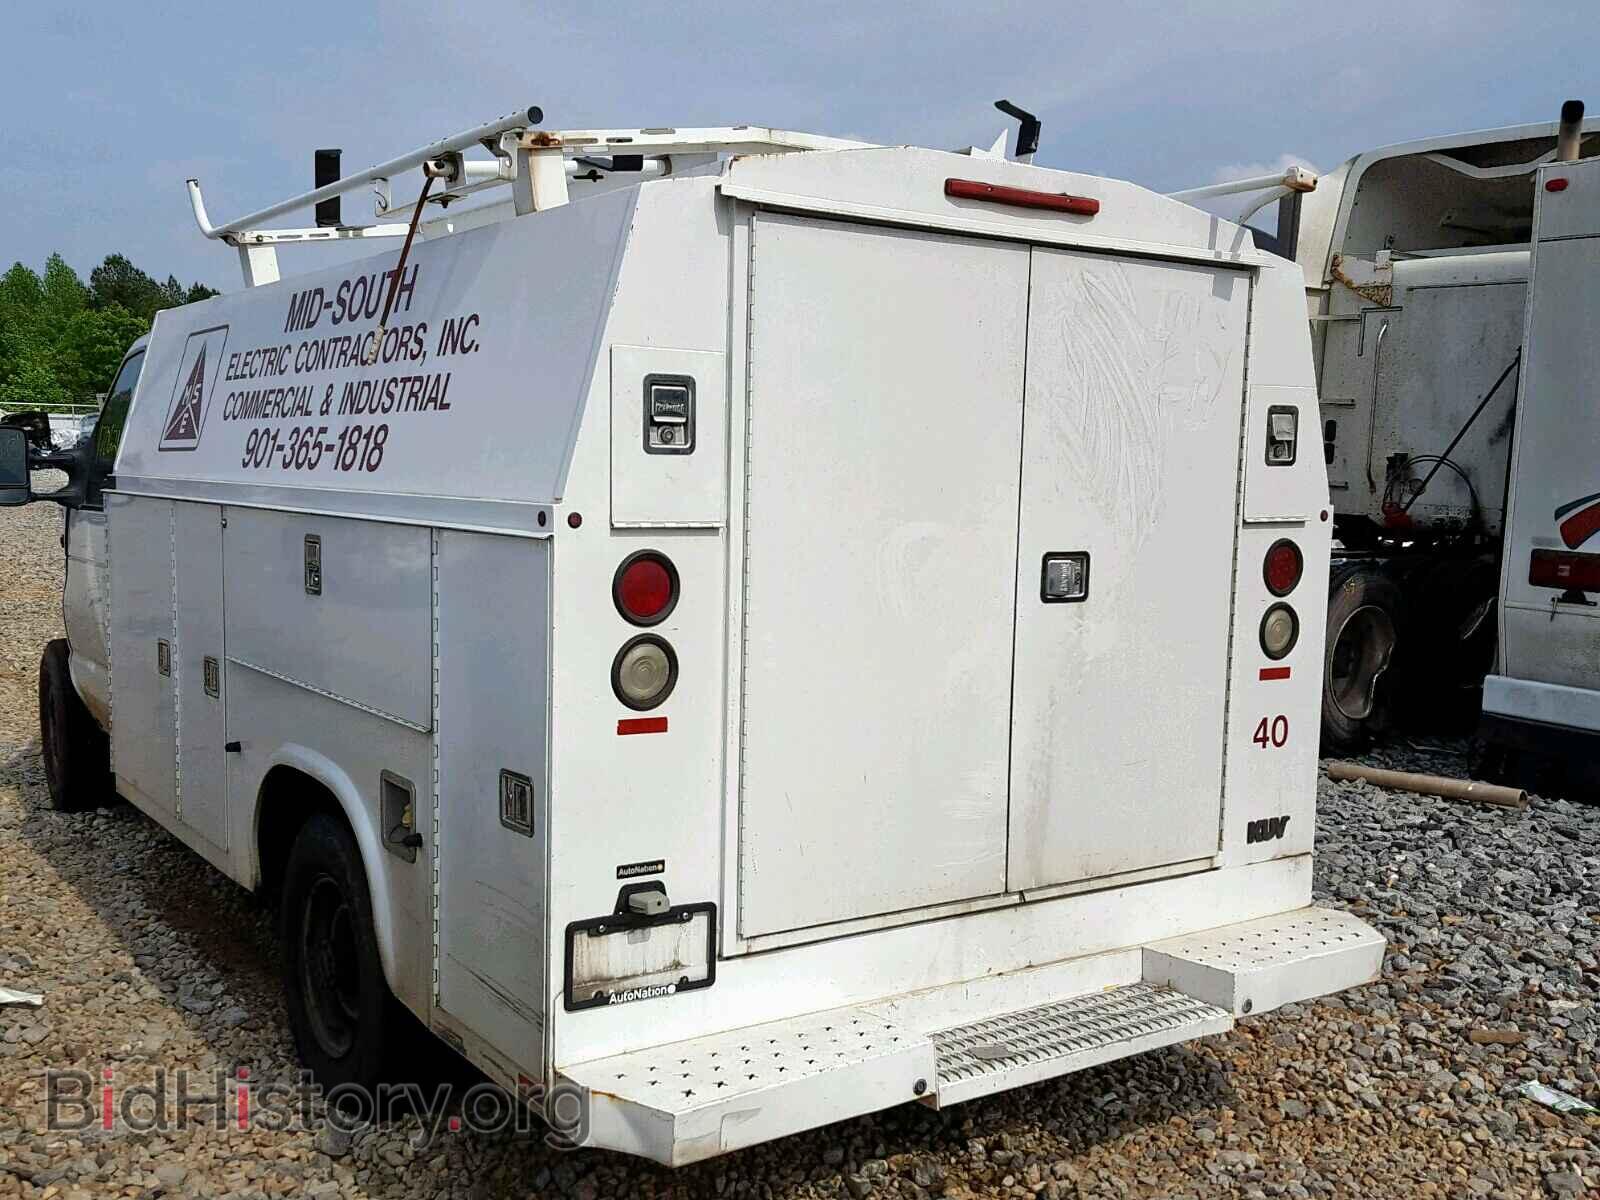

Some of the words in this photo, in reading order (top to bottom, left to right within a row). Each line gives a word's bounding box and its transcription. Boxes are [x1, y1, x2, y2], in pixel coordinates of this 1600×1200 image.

[225, 343, 289, 382] ELECTRIC
[436, 313, 480, 357] INC.
[223, 382, 312, 421] COMMERCIAL
[319, 383, 335, 416] &
[338, 373, 451, 415] INDUSTRIAL
[242, 423, 389, 473] 901-365-1818
[1253, 714, 1289, 749] 40
[1246, 815, 1290, 844] KUV
[617, 864, 658, 876] AutoNation
[608, 985, 668, 1004] AutoNation
